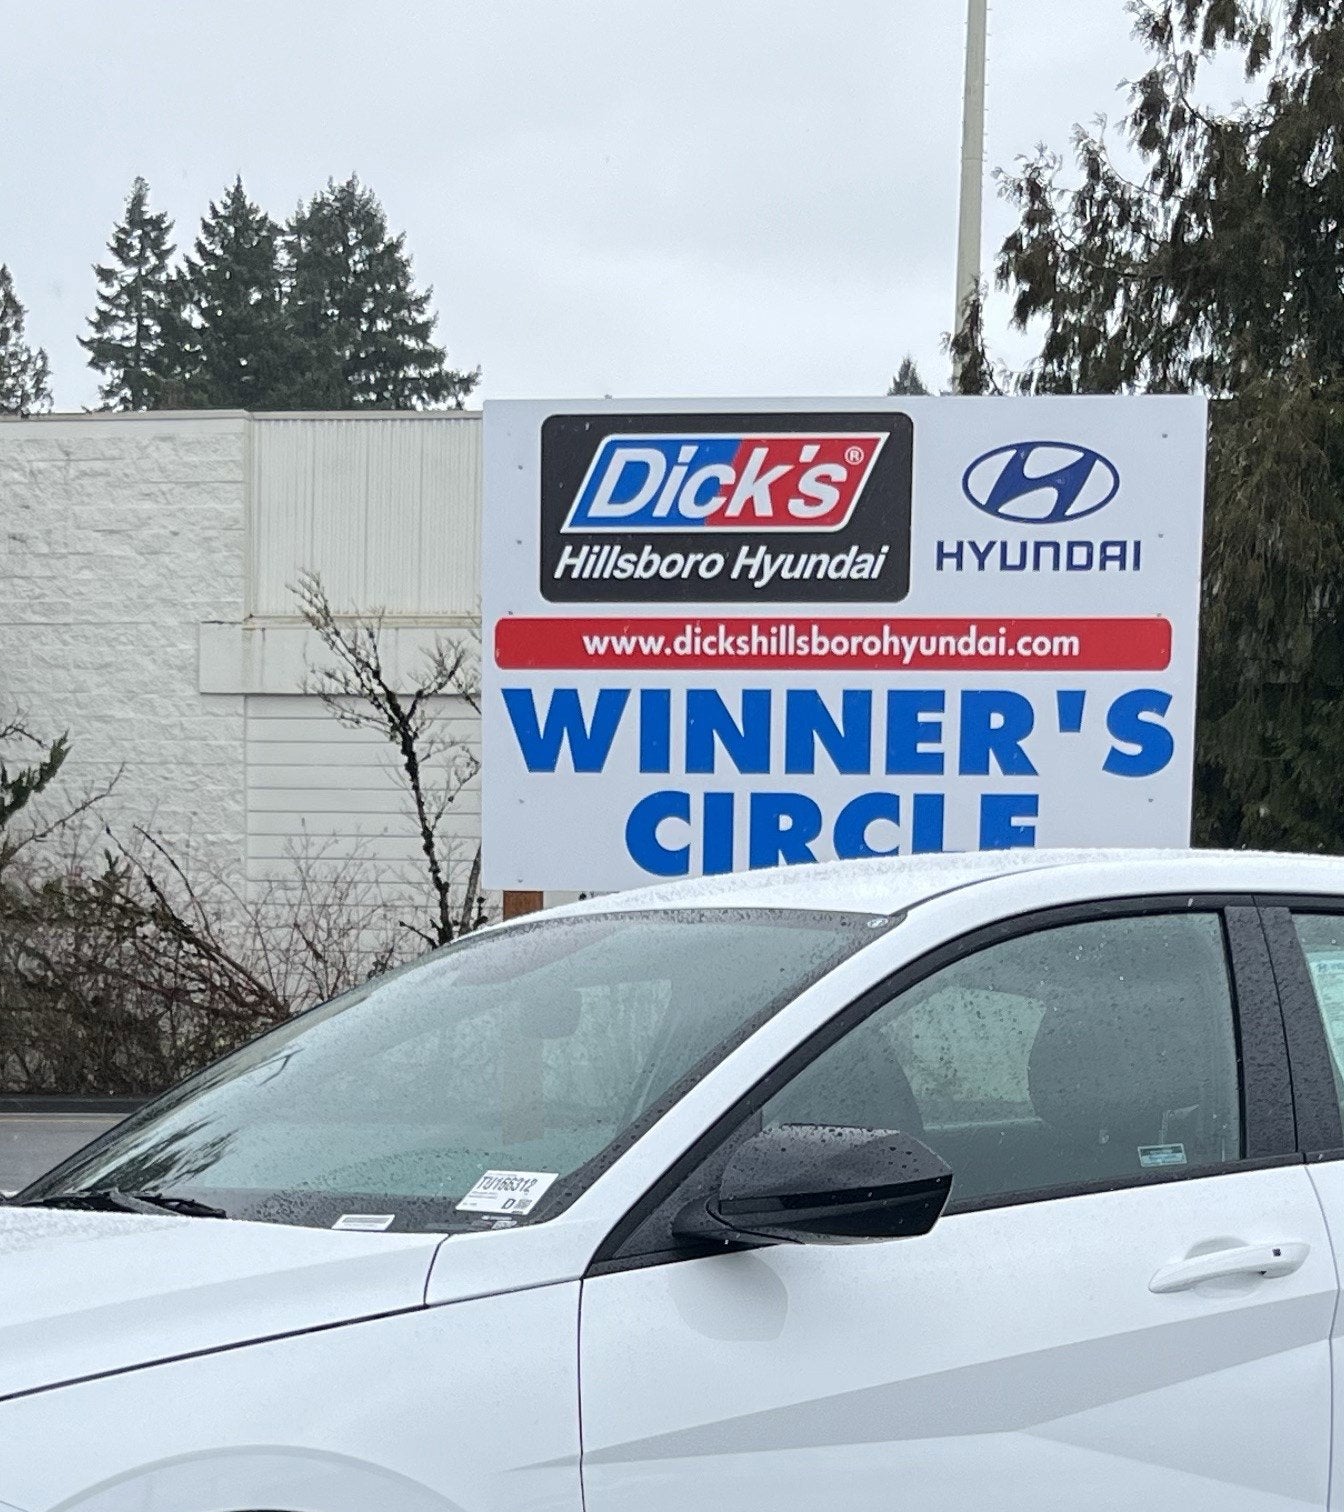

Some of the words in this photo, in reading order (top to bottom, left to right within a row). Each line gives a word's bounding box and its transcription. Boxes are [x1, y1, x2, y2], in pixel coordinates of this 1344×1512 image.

[554, 543, 724, 581] Hillsboro
[730, 544, 890, 588] Hyundai
[935, 539, 1142, 572] HYUNDAI
[582, 626, 1080, 665] www.dickshillsborohyundai.com
[501, 687, 1174, 777] WINNER'S
[624, 788, 1040, 877] CIRCLE
